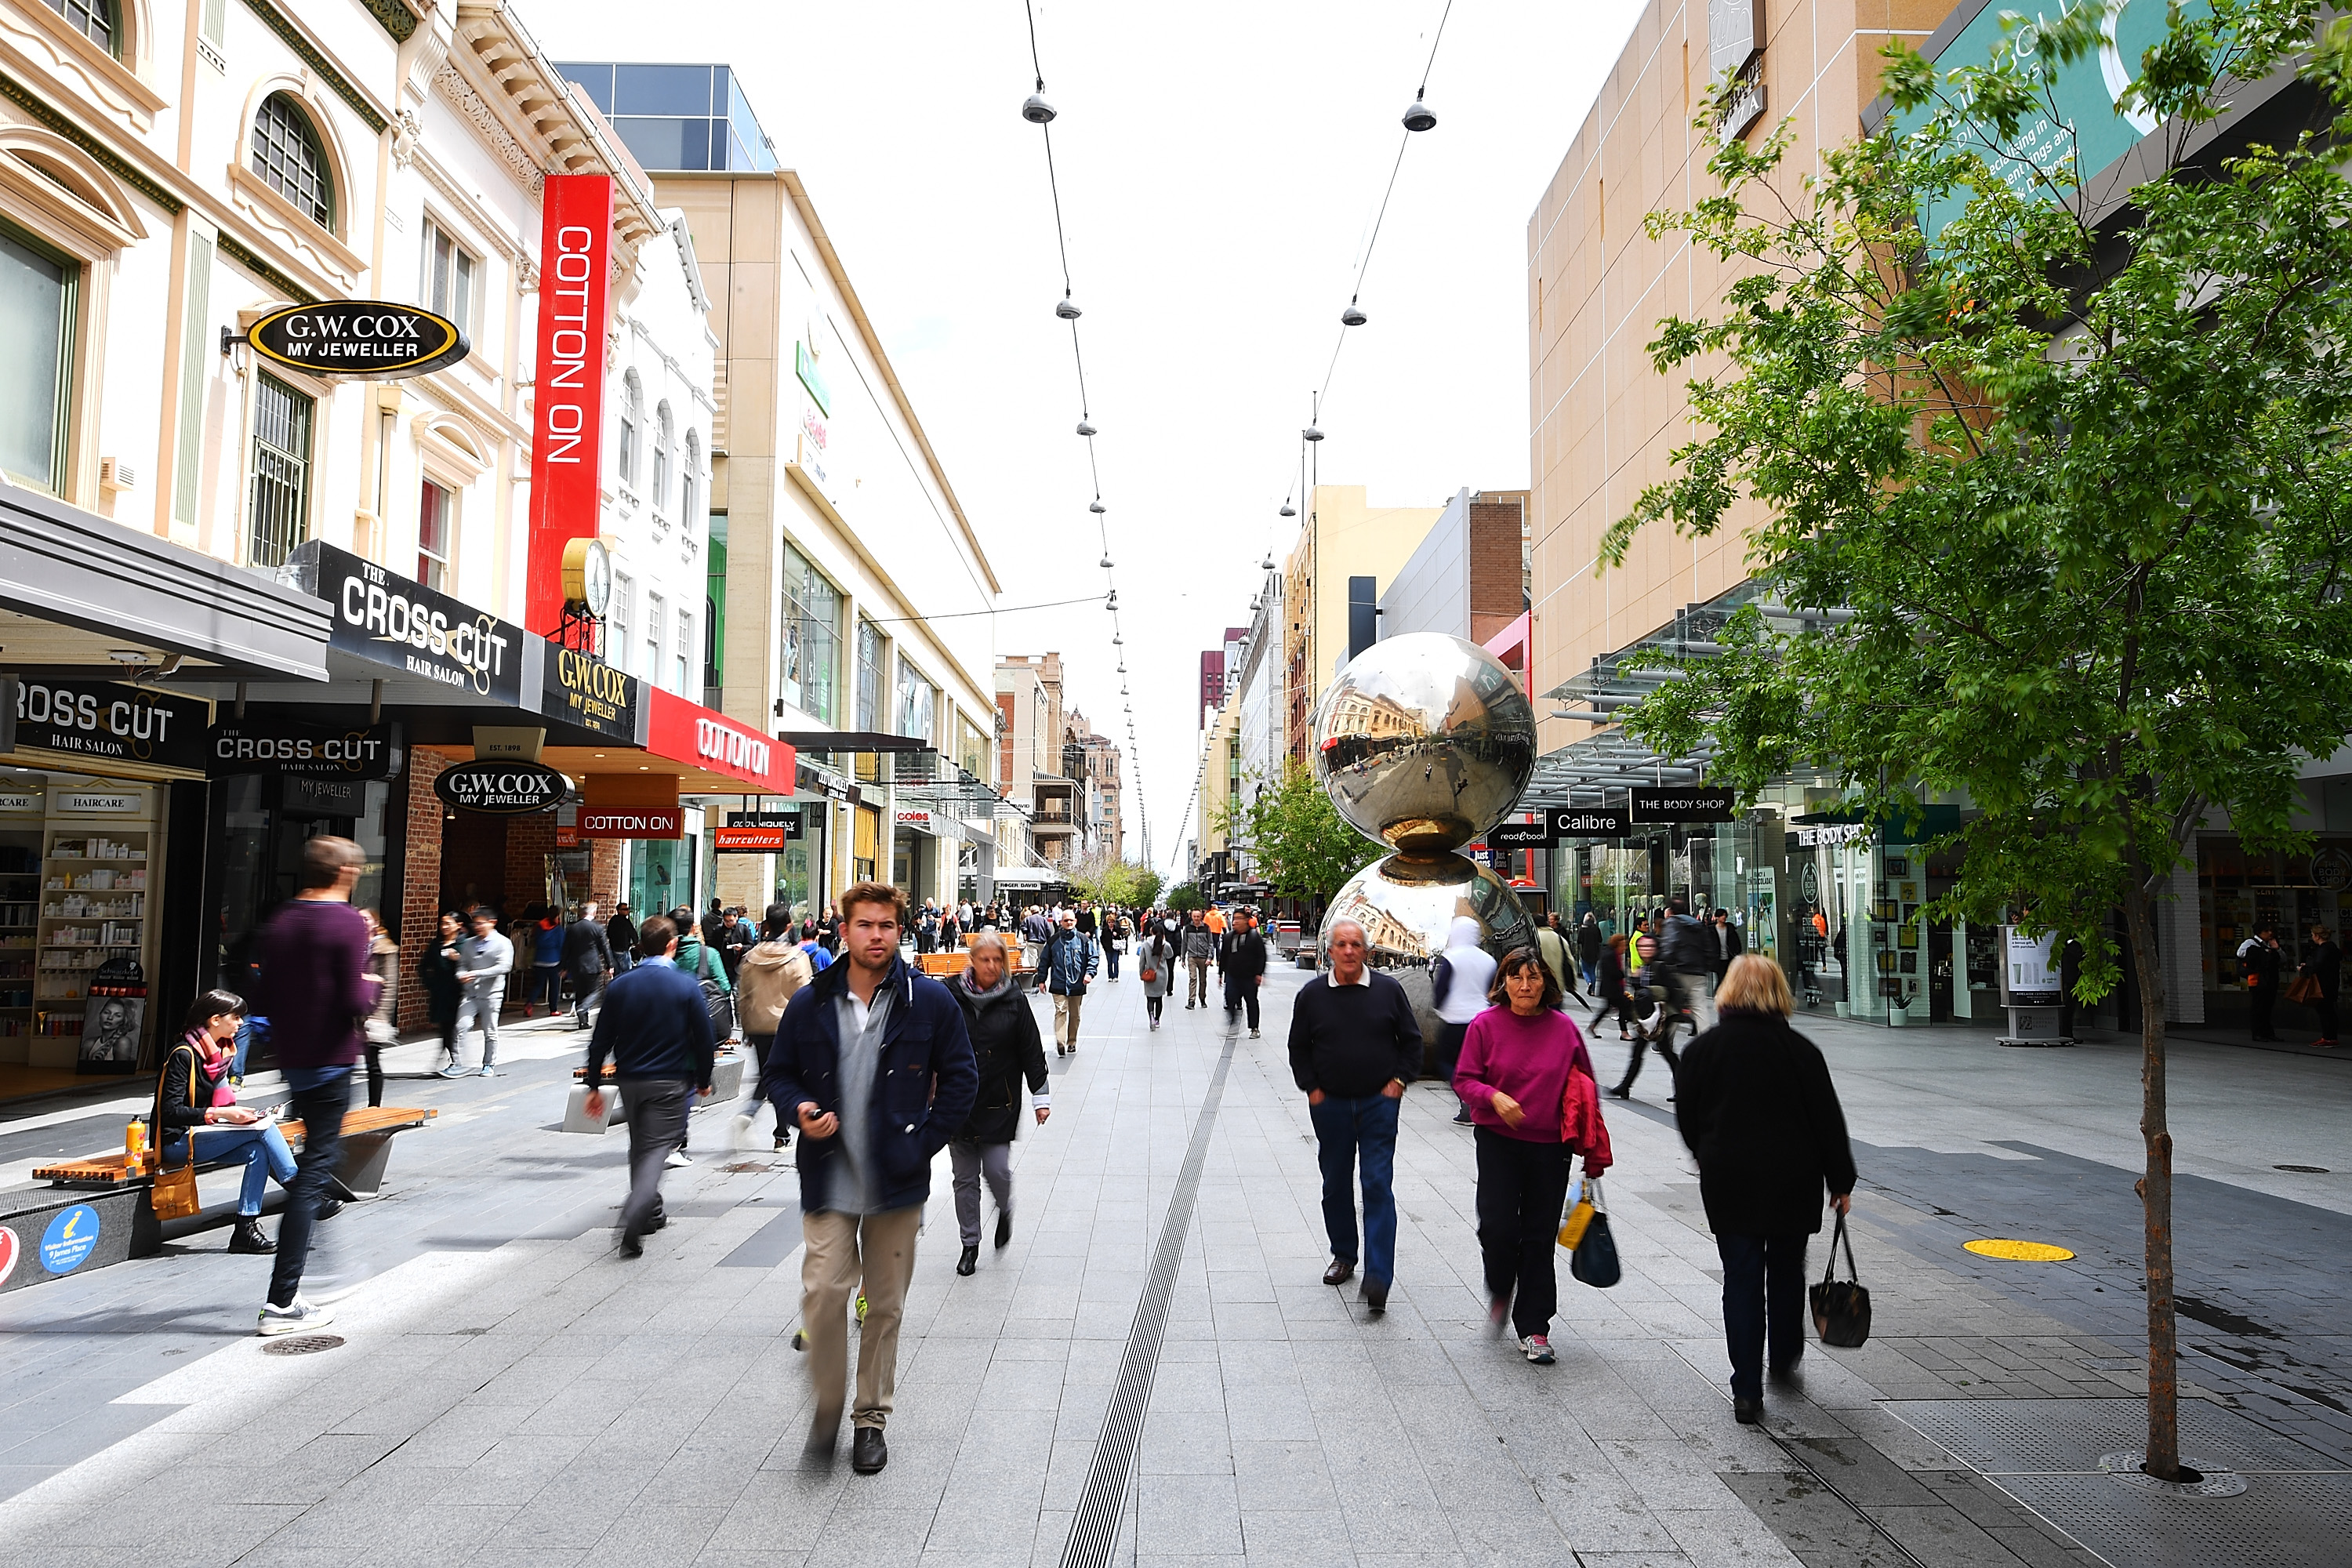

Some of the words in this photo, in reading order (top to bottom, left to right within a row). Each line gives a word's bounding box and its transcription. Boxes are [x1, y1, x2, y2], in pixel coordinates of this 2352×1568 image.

[2053, 118, 2075, 147] and
[1990, 129, 2036, 176] ecialising
[2035, 119, 2048, 136] in
[550, 226, 592, 388] COTTON
[353, 315, 420, 338] COX
[287, 343, 313, 357] MY
[318, 343, 418, 357] JEWELLER
[546, 404, 583, 463] ON
[362, 562, 387, 586] THE
[343, 575, 448, 655] CROSS
[456, 622, 507, 676] CUT
[406, 655, 431, 677] HAIR
[434, 665, 465, 688] SALON
[593, 663, 627, 708] COX
[16, 681, 97, 730] ROSS
[111, 701, 173, 742] CUT
[569, 692, 583, 710] MY
[583, 698, 616, 721] JEWELLER
[52, 734, 82, 750] HAIR
[85, 739, 123, 755] SALON
[217, 739, 313, 759] CROSS
[324, 739, 381, 760] CUT
[696, 718, 751, 770] COTTON
[751, 740, 770, 776] ON
[301, 780, 313, 793] MY
[314, 782, 351, 799] JEWELLER
[498, 775, 552, 793] COX
[73, 798, 125, 808] HAIRCARE
[459, 794, 479, 804] MY
[483, 794, 539, 806] JEWELLER
[1639, 800, 1660, 809] THE
[1664, 800, 1693, 809] BODY
[1696, 800, 1725, 809] SHOP
[585, 816, 646, 829] COTTON
[650, 816, 673, 830] ON
[897, 811, 929, 821] coles
[1558, 815, 1616, 829] Calibre
[718, 835, 782, 844] haircutters
[1797, 829, 1817, 846] THE
[1817, 826, 1842, 844] BODY
[1475, 851, 1489, 861] Just
[2318, 868, 2347, 877] BODY
[45, 1243, 63, 1251] Visitor
[63, 1236, 93, 1247] Information
[53, 1248, 71, 1259] James
